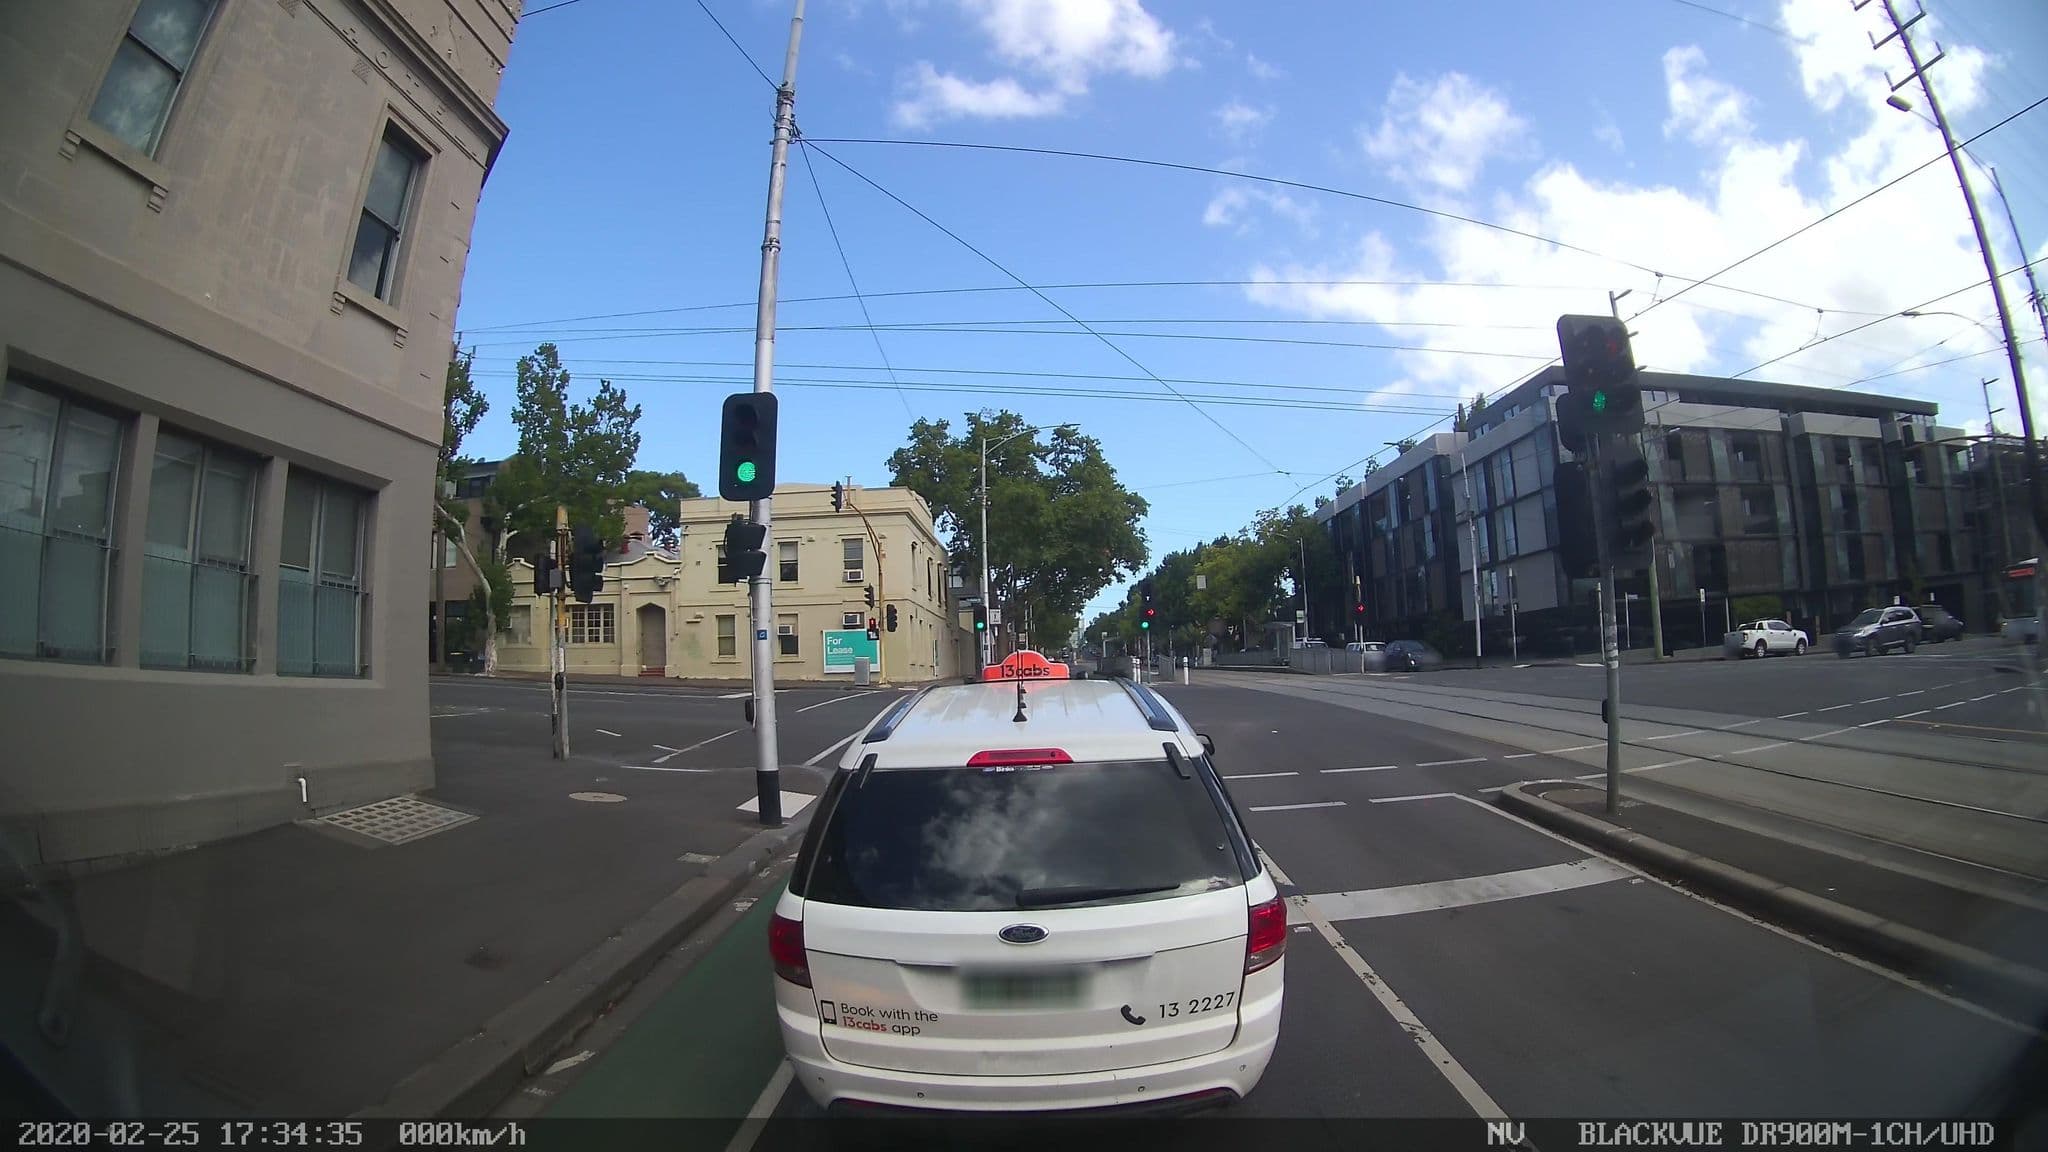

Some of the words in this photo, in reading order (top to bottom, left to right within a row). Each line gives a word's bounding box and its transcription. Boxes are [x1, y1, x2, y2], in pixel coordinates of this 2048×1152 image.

[826, 636, 843, 645] For
[827, 646, 854, 655] Lease
[1001, 664, 1050, 678] 13cabs
[841, 1002, 875, 1018] Book
[879, 1009, 910, 1021] with
[915, 1010, 939, 1022] the
[1159, 1002, 1180, 1019] 13
[1189, 991, 1235, 1015] 2227
[842, 1016, 888, 1033] 13cabs
[891, 1024, 921, 1037] app
